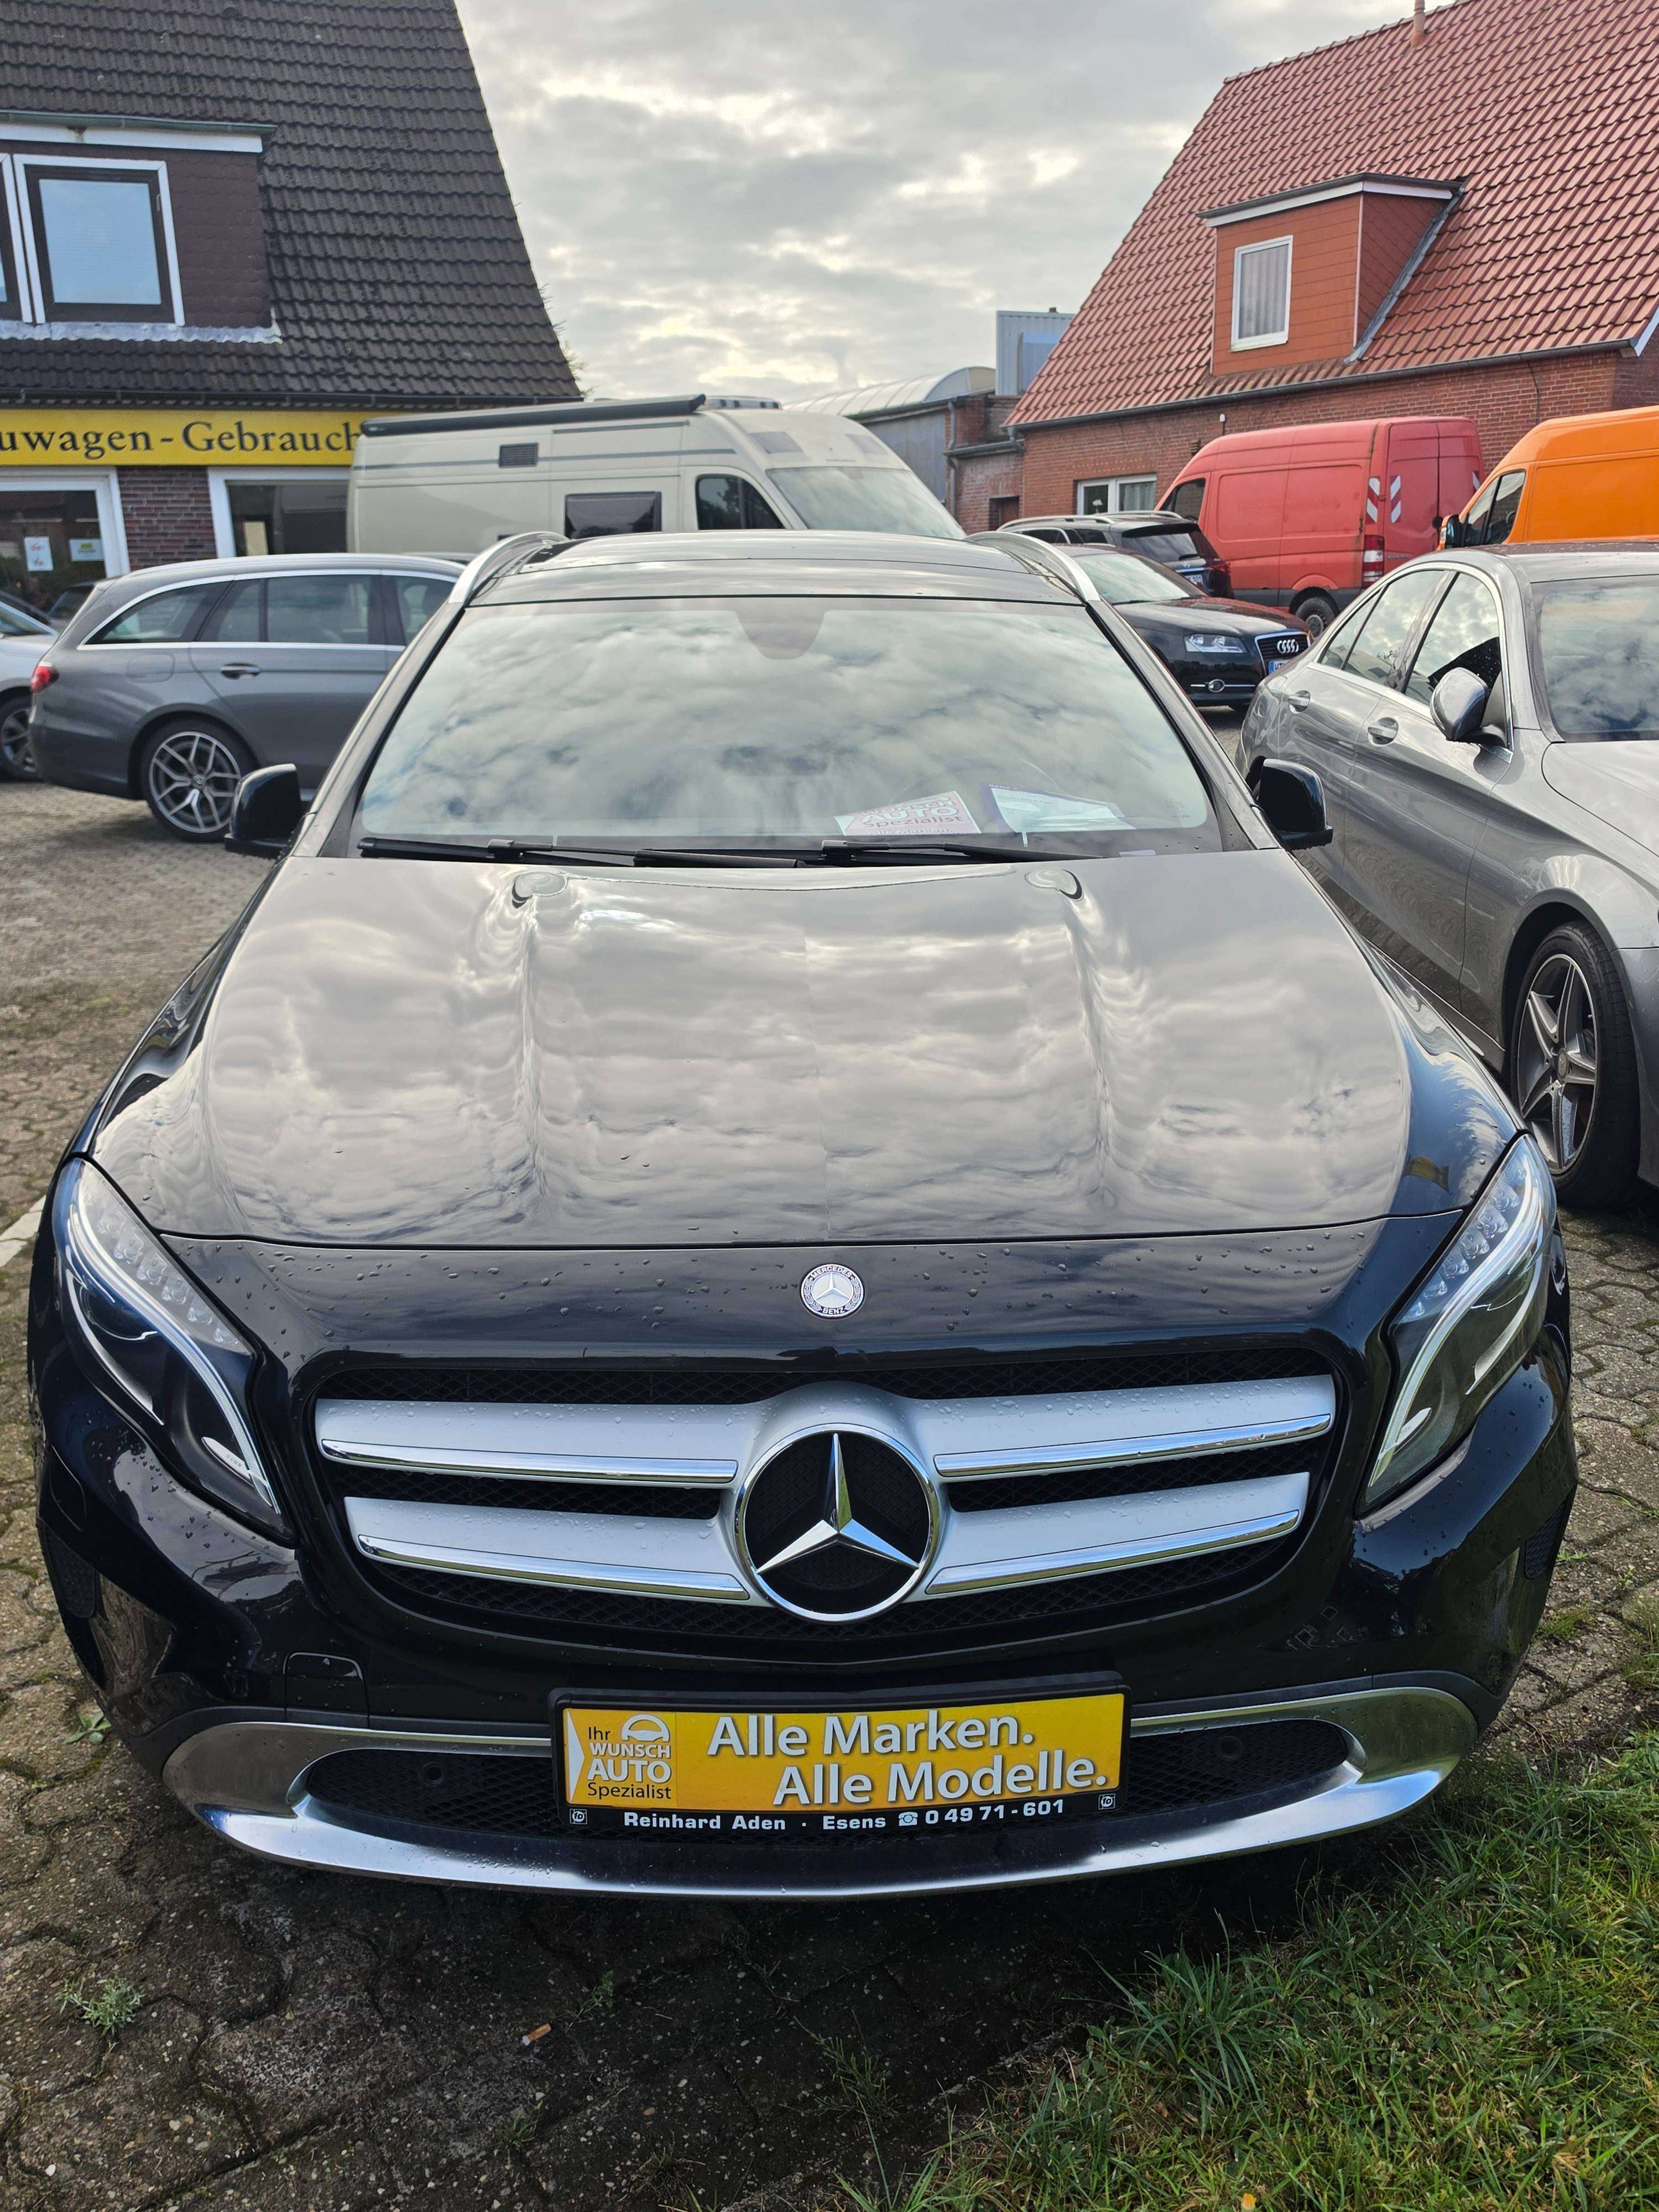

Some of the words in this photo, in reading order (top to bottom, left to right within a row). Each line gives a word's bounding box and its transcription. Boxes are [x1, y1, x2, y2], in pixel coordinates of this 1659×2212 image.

[861, 807, 958, 823] AUTO
[862, 816, 963, 828] Spezialist
[810, 1265, 853, 1279] MERCEDES
[822, 1307, 846, 1315] BENZ
[588, 1726, 611, 1740] Ihr
[707, 1714, 807, 1756] Alle
[823, 1710, 1034, 1755] Marken.
[589, 1742, 671, 1759] WUNSCH
[587, 1758, 672, 1784] AUTO
[773, 1763, 872, 1805] Alle
[888, 1749, 1107, 1802] Modelle.
[587, 1782, 671, 1800] Spezialist
[624, 1812, 721, 1829] Reinhard
[731, 1815, 786, 1830] Aden
[823, 1815, 886, 1830] Esens
